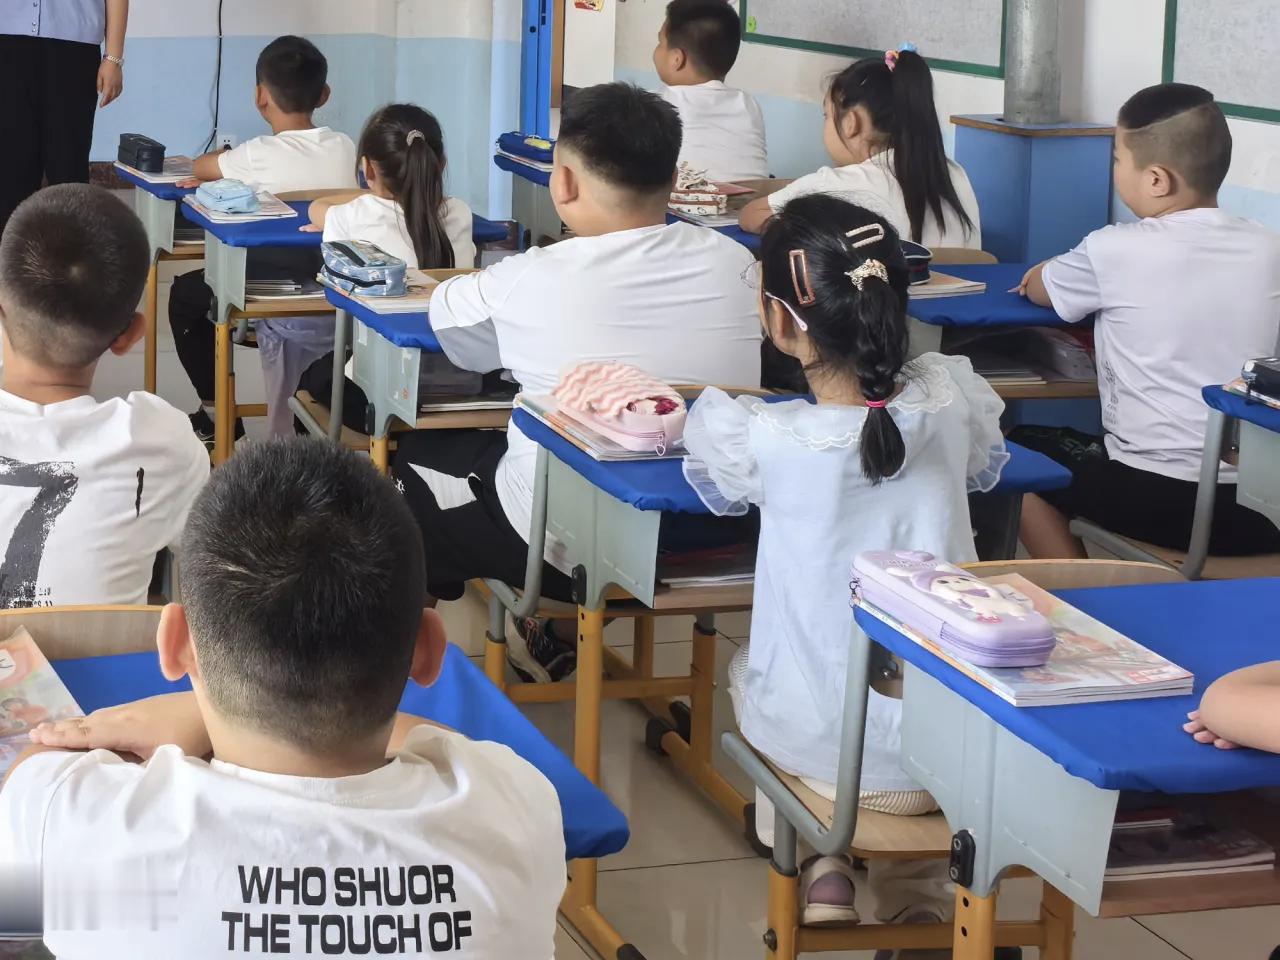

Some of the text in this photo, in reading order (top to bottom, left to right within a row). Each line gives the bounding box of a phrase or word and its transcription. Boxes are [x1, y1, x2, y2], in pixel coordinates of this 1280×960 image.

[237, 864, 457, 907] WHO SHUOR
[221, 910, 473, 955] THE TOUCH OF
